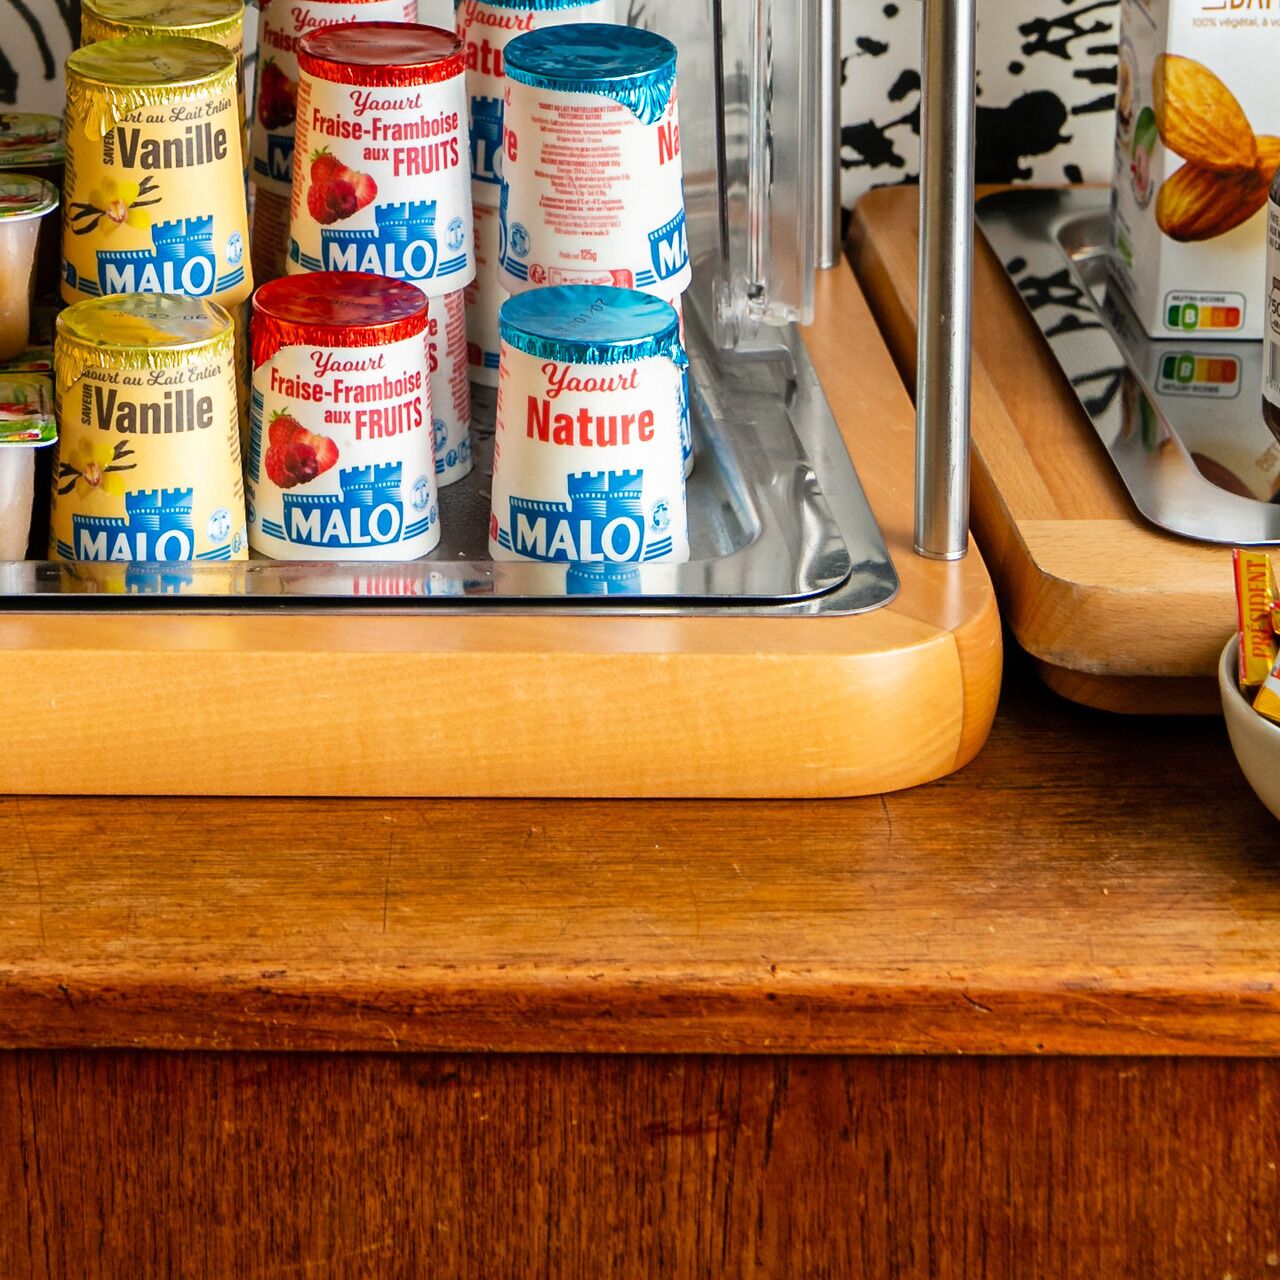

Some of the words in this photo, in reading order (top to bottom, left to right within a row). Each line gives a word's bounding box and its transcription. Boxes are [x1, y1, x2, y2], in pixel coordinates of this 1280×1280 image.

[464, 1, 535, 32] Yaourt
[1192, 17, 1217, 28] 100%
[146, 114, 165, 124] au
[169, 106, 204, 122] Lait
[205, 97, 232, 117] Entier
[349, 90, 422, 115] Yaourt
[312, 107, 459, 141] Fraise-Framboise
[103, 126, 115, 166] SAVEU
[117, 122, 228, 170] Vanille
[363, 146, 389, 161] aux
[393, 137, 459, 176] FRUITS
[328, 239, 435, 278] MALO
[580, 248, 597, 262] 125g
[658, 222, 688, 277] MA
[105, 255, 214, 297] MALO
[123, 376, 143, 386] au
[147, 370, 185, 386] Lait
[188, 364, 222, 382] Entier
[310, 350, 385, 377] Yaourt
[541, 363, 640, 399] Yaourt
[270, 366, 421, 404] Fraise-Framboise
[81, 384, 93, 426] SAVEUR
[94, 386, 213, 434] Vanille
[324, 408, 351, 424] aux
[355, 397, 422, 440] FRUITS
[526, 396, 655, 448] Nature
[290, 503, 400, 544] MALO
[516, 513, 641, 562] MALO
[80, 529, 190, 560] MALO
[1246, 559, 1272, 658] PRÉSIDENT
